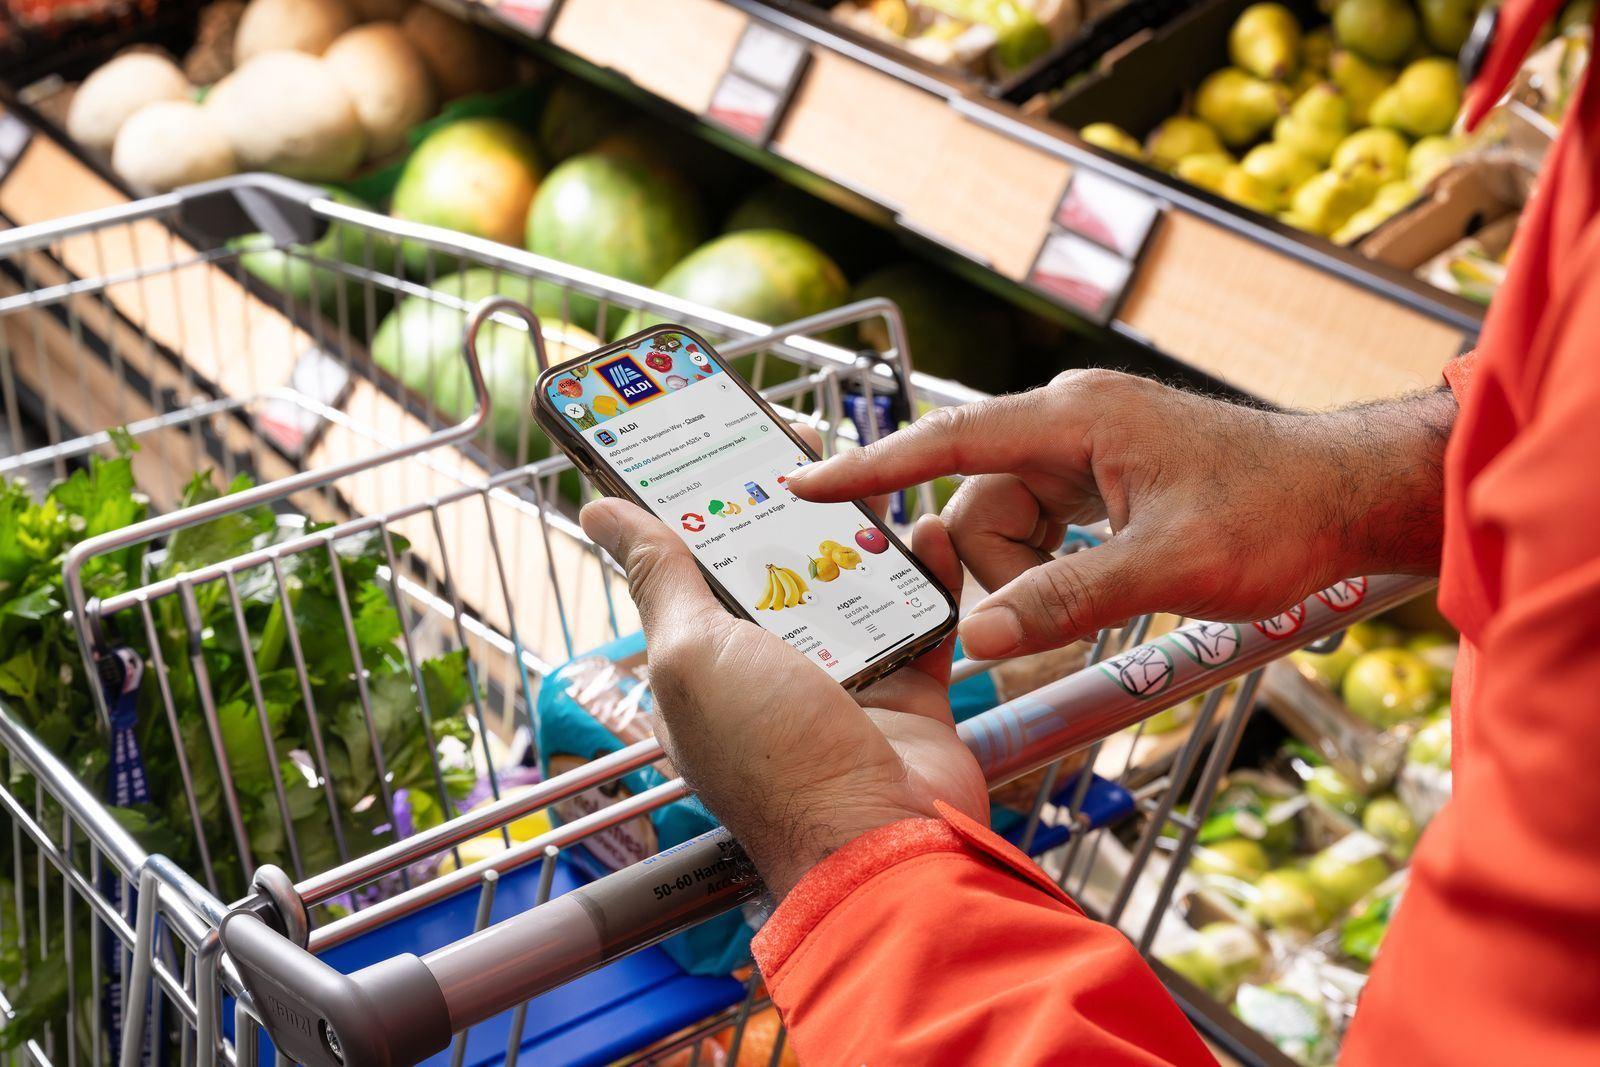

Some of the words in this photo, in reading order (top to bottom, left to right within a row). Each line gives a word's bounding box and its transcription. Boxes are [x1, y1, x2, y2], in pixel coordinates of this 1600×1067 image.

[623, 380, 653, 398] ALDI
[619, 422, 639, 435] ALDI
[725, 418, 740, 429] Pricing
[609, 449, 621, 458] 400
[621, 442, 639, 453] metres
[647, 425, 672, 441] Benjamin
[670, 422, 684, 433] Way
[685, 413, 705, 425] Change
[623, 455, 634, 463] min
[630, 458, 651, 472] A$0.00
[651, 450, 671, 462] delivery
[669, 447, 678, 455] fee
[650, 467, 676, 483] Freshness
[675, 456, 703, 473] guaranteed
[707, 448, 719, 460] your
[718, 441, 735, 454] money
[733, 436, 747, 445] back
[665, 486, 688, 502] Search
[686, 481, 703, 493] ALDI
[754, 509, 771, 521] Dairy
[771, 502, 786, 514] Eggs
[729, 519, 752, 534] Produce
[695, 540, 707, 552] Buy
[710, 532, 727, 545] Again
[713, 557, 733, 571] Fruit
[850, 610, 871, 627] Imperial
[869, 599, 895, 617] Mandarins
[826, 659, 840, 669] Store
[653, 874, 693, 900] 50-60
